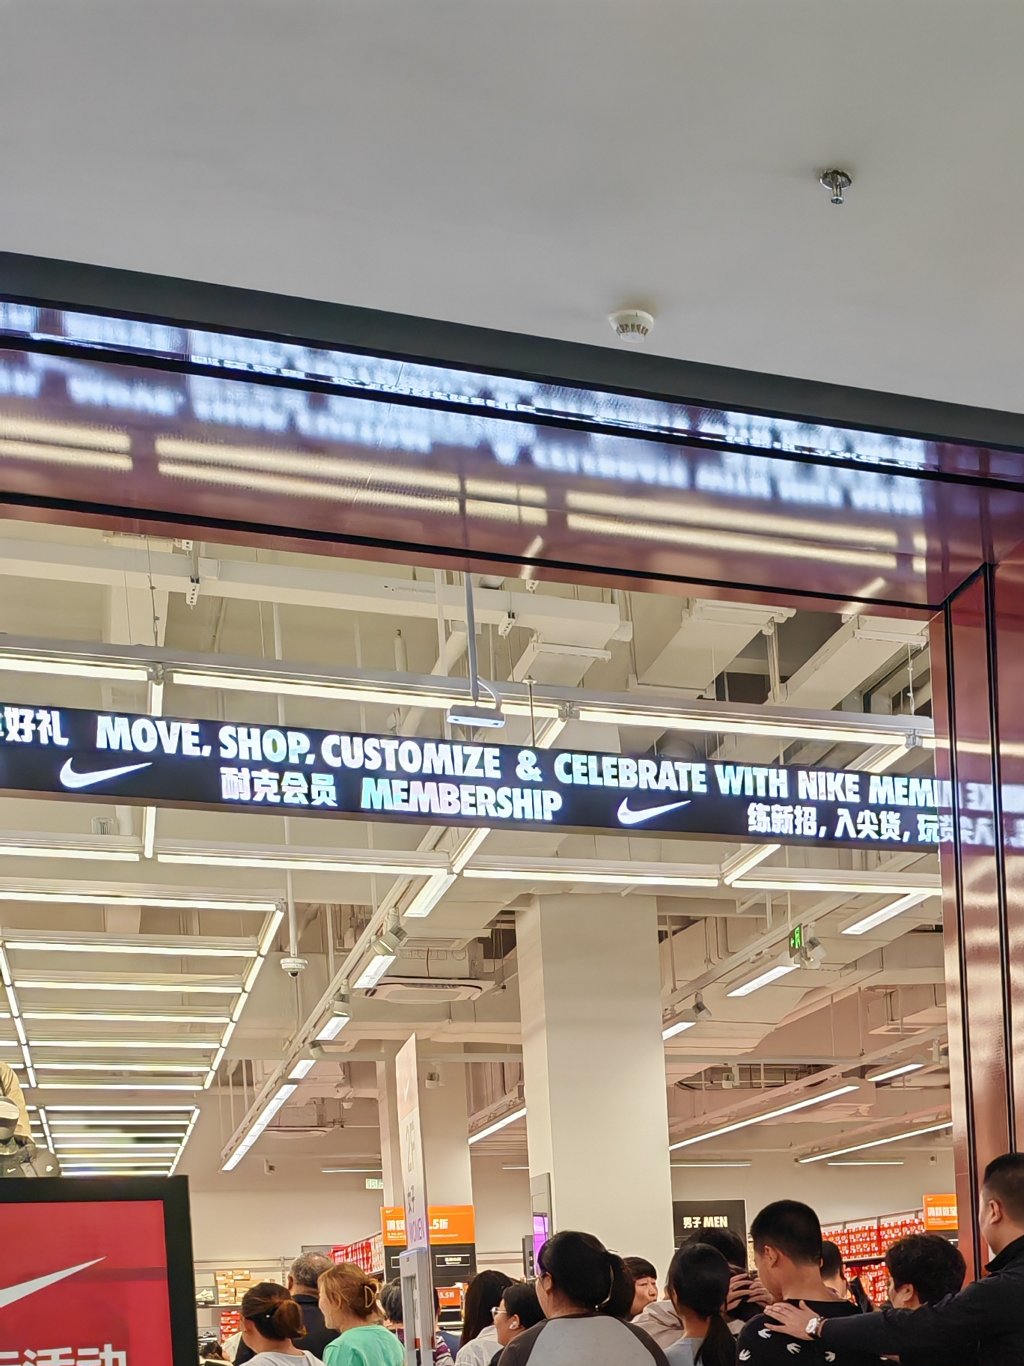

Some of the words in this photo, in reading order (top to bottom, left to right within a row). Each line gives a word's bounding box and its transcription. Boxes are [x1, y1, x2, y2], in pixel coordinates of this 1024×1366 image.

[0, 706, 69, 746] 好礼
[220, 766, 338, 806] 耐克会员
[321, 735, 501, 779] CUSTOMIZE
[516, 750, 543, 782] &
[554, 753, 707, 793] CELEBRATE
[714, 764, 789, 799] WITH
[797, 771, 860, 802] NIKE
[361, 777, 562, 820] MEMBERSHIP
[683, 1216, 702, 1229] 男子
[703, 1216, 728, 1228] MEN
